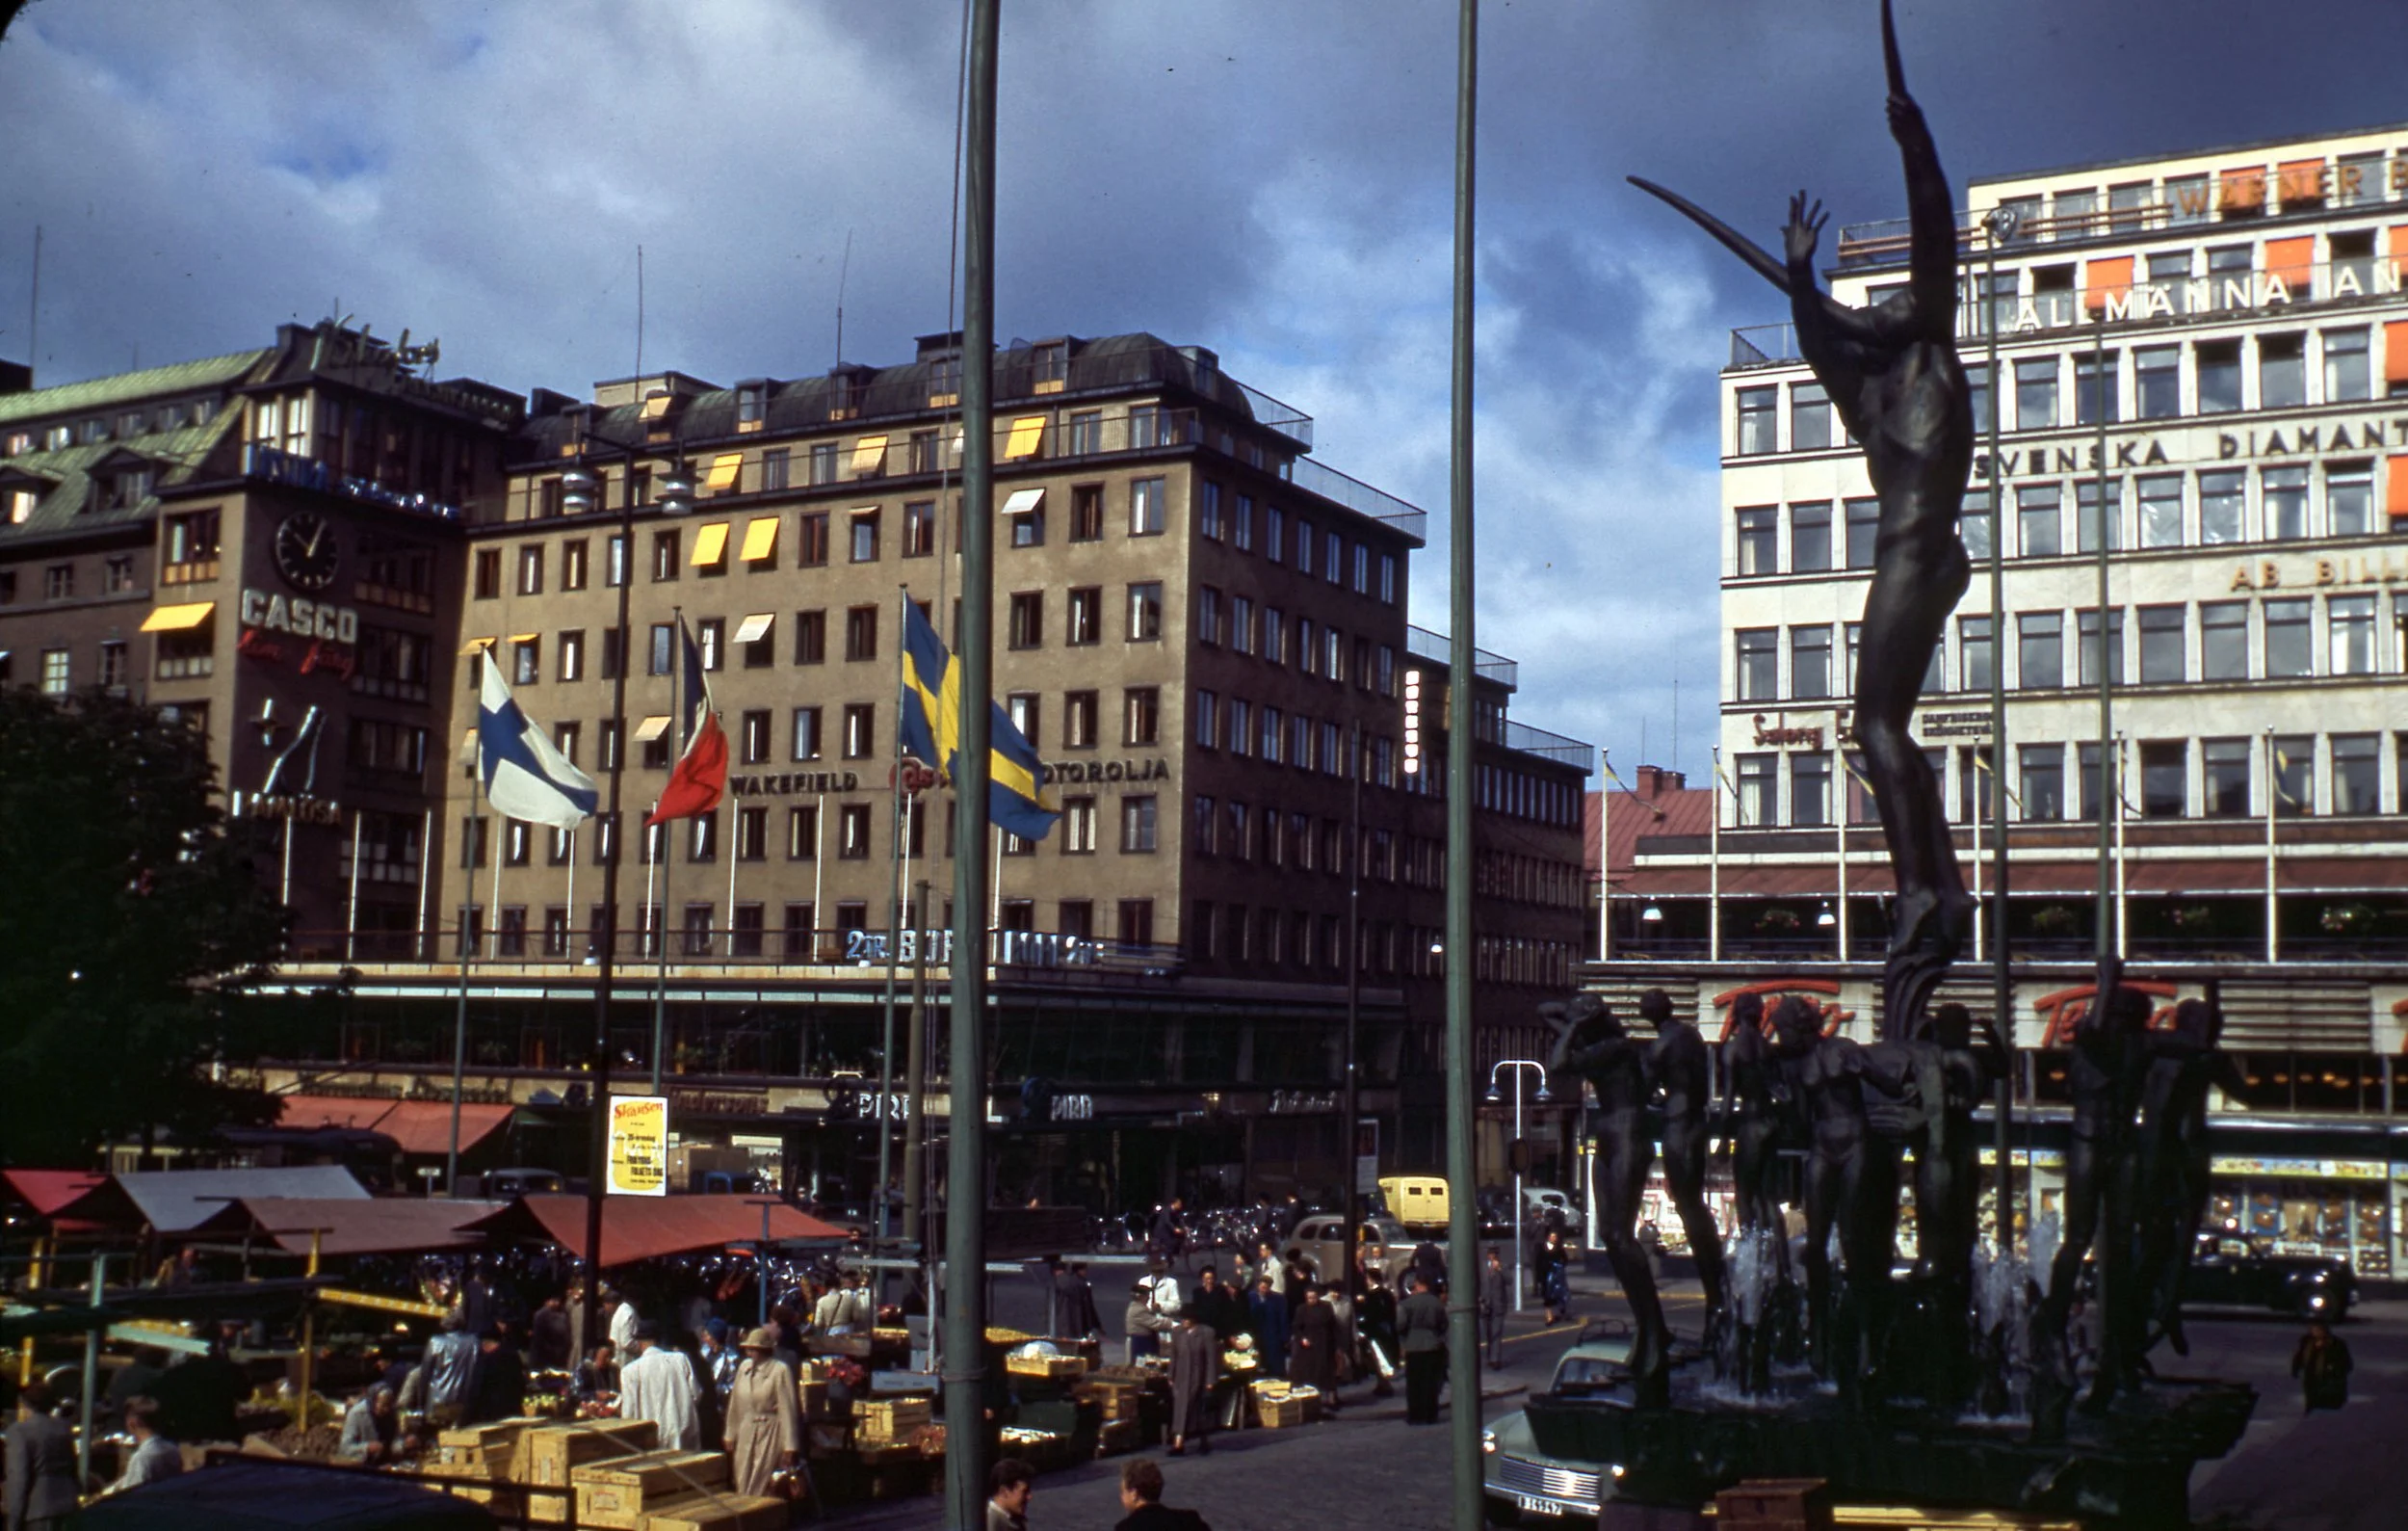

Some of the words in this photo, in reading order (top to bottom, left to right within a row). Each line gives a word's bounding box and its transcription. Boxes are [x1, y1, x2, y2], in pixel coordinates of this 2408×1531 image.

[2177, 165, 2363, 216] WARNER
[2015, 274, 2292, 331] ALLMÄNNA
[1975, 440, 2169, 480] SVENSKA
[2231, 561, 2280, 593] AB
[242, 589, 358, 644] CASCO
[729, 772, 857, 797] WAKEFIELD
[1044, 756, 1170, 784] OTOROLJA
[615, 1102, 664, 1119] Skansen
